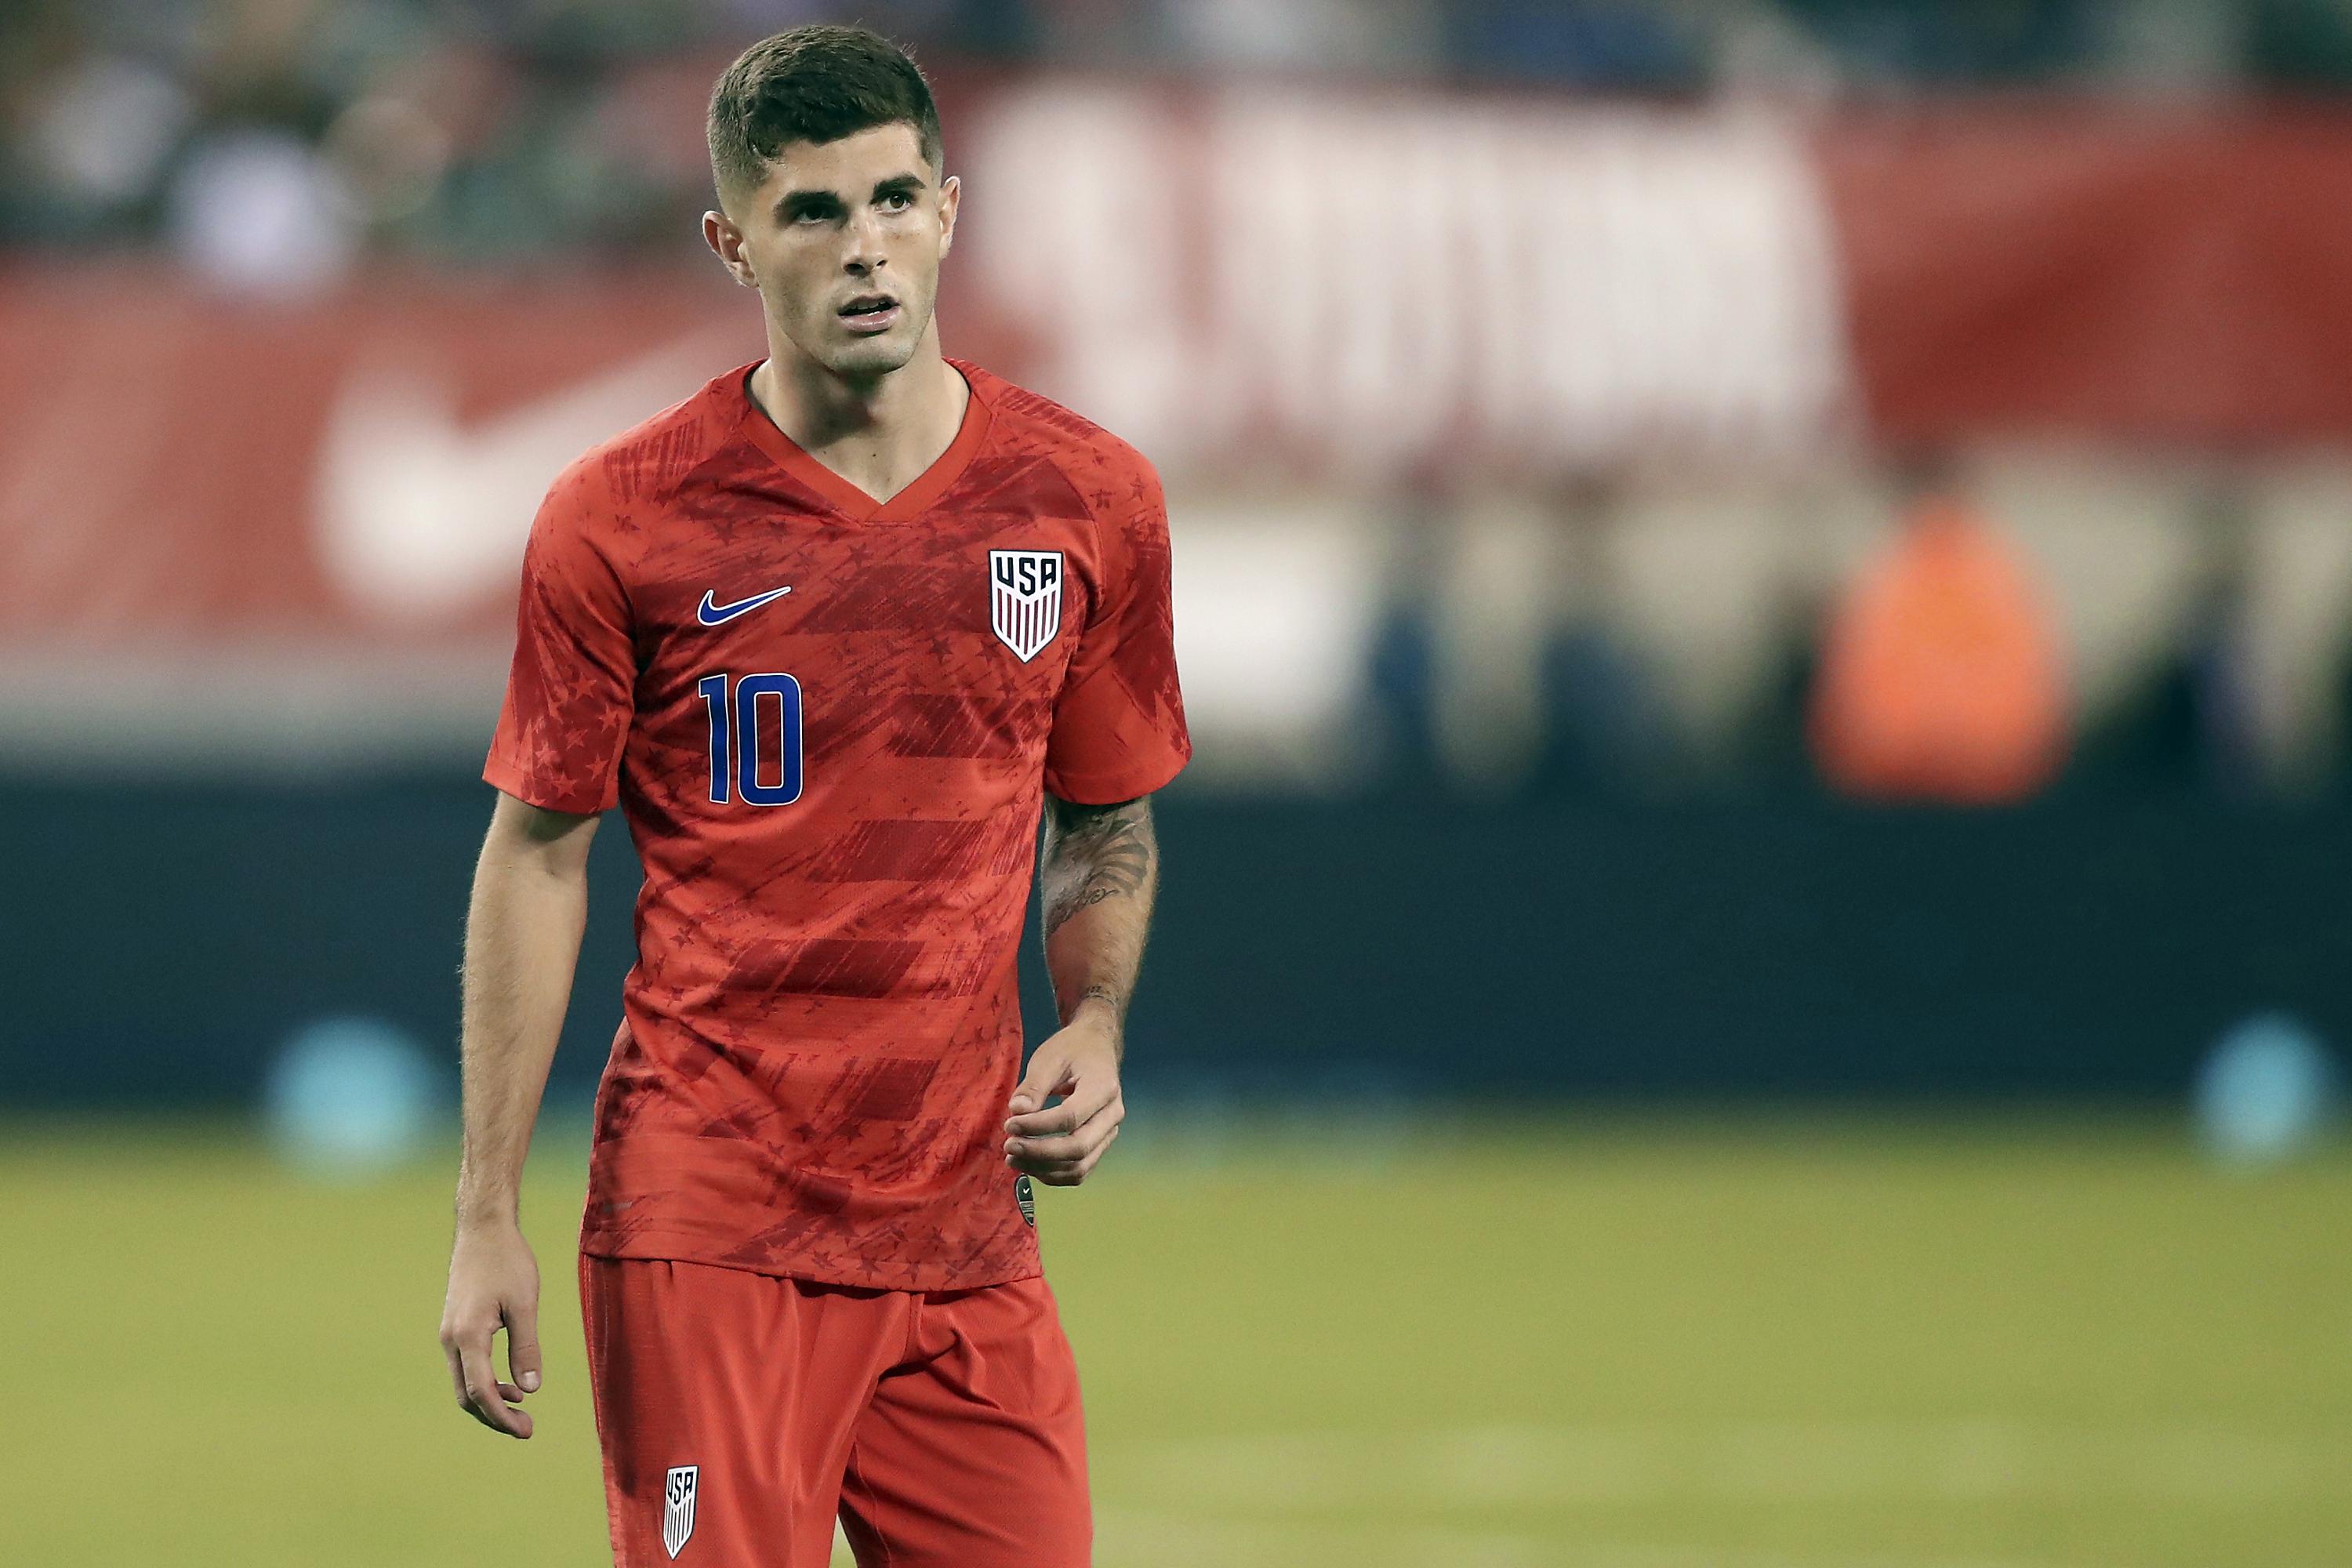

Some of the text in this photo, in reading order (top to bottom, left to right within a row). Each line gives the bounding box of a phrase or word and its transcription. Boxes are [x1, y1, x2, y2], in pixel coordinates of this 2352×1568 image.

[996, 557, 1057, 597] USA
[699, 672, 804, 806] 10
[667, 1472, 694, 1505] USA
